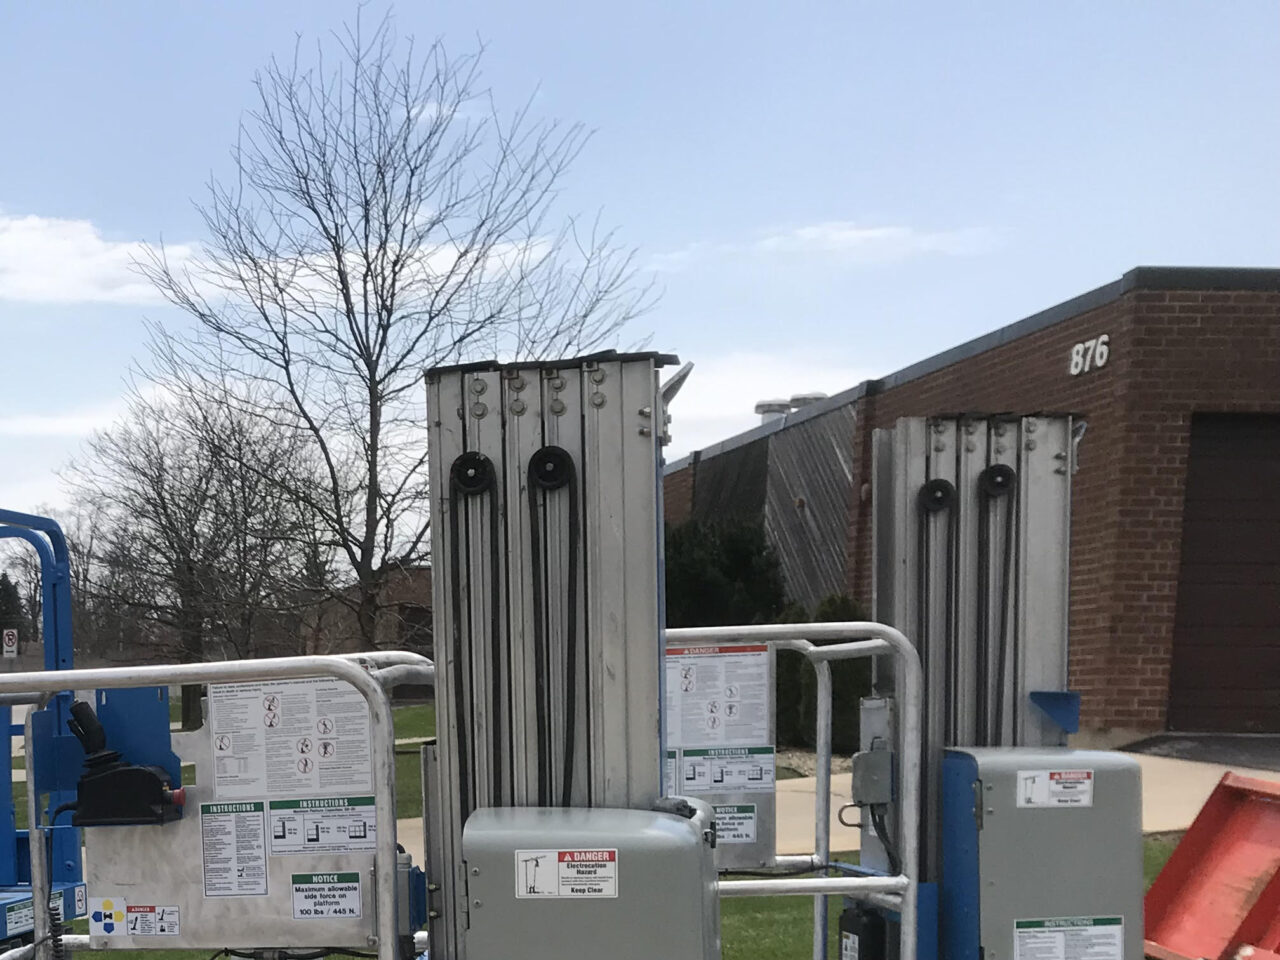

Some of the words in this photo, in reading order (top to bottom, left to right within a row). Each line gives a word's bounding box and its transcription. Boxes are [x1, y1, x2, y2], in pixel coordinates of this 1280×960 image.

[1070, 334, 1109, 375] 876
[210, 803, 255, 812] INSTRUCTIONS
[300, 799, 348, 808] INSTRUCTIONS
[574, 852, 610, 861] DANGER
[312, 875, 338, 883] NOTICE
